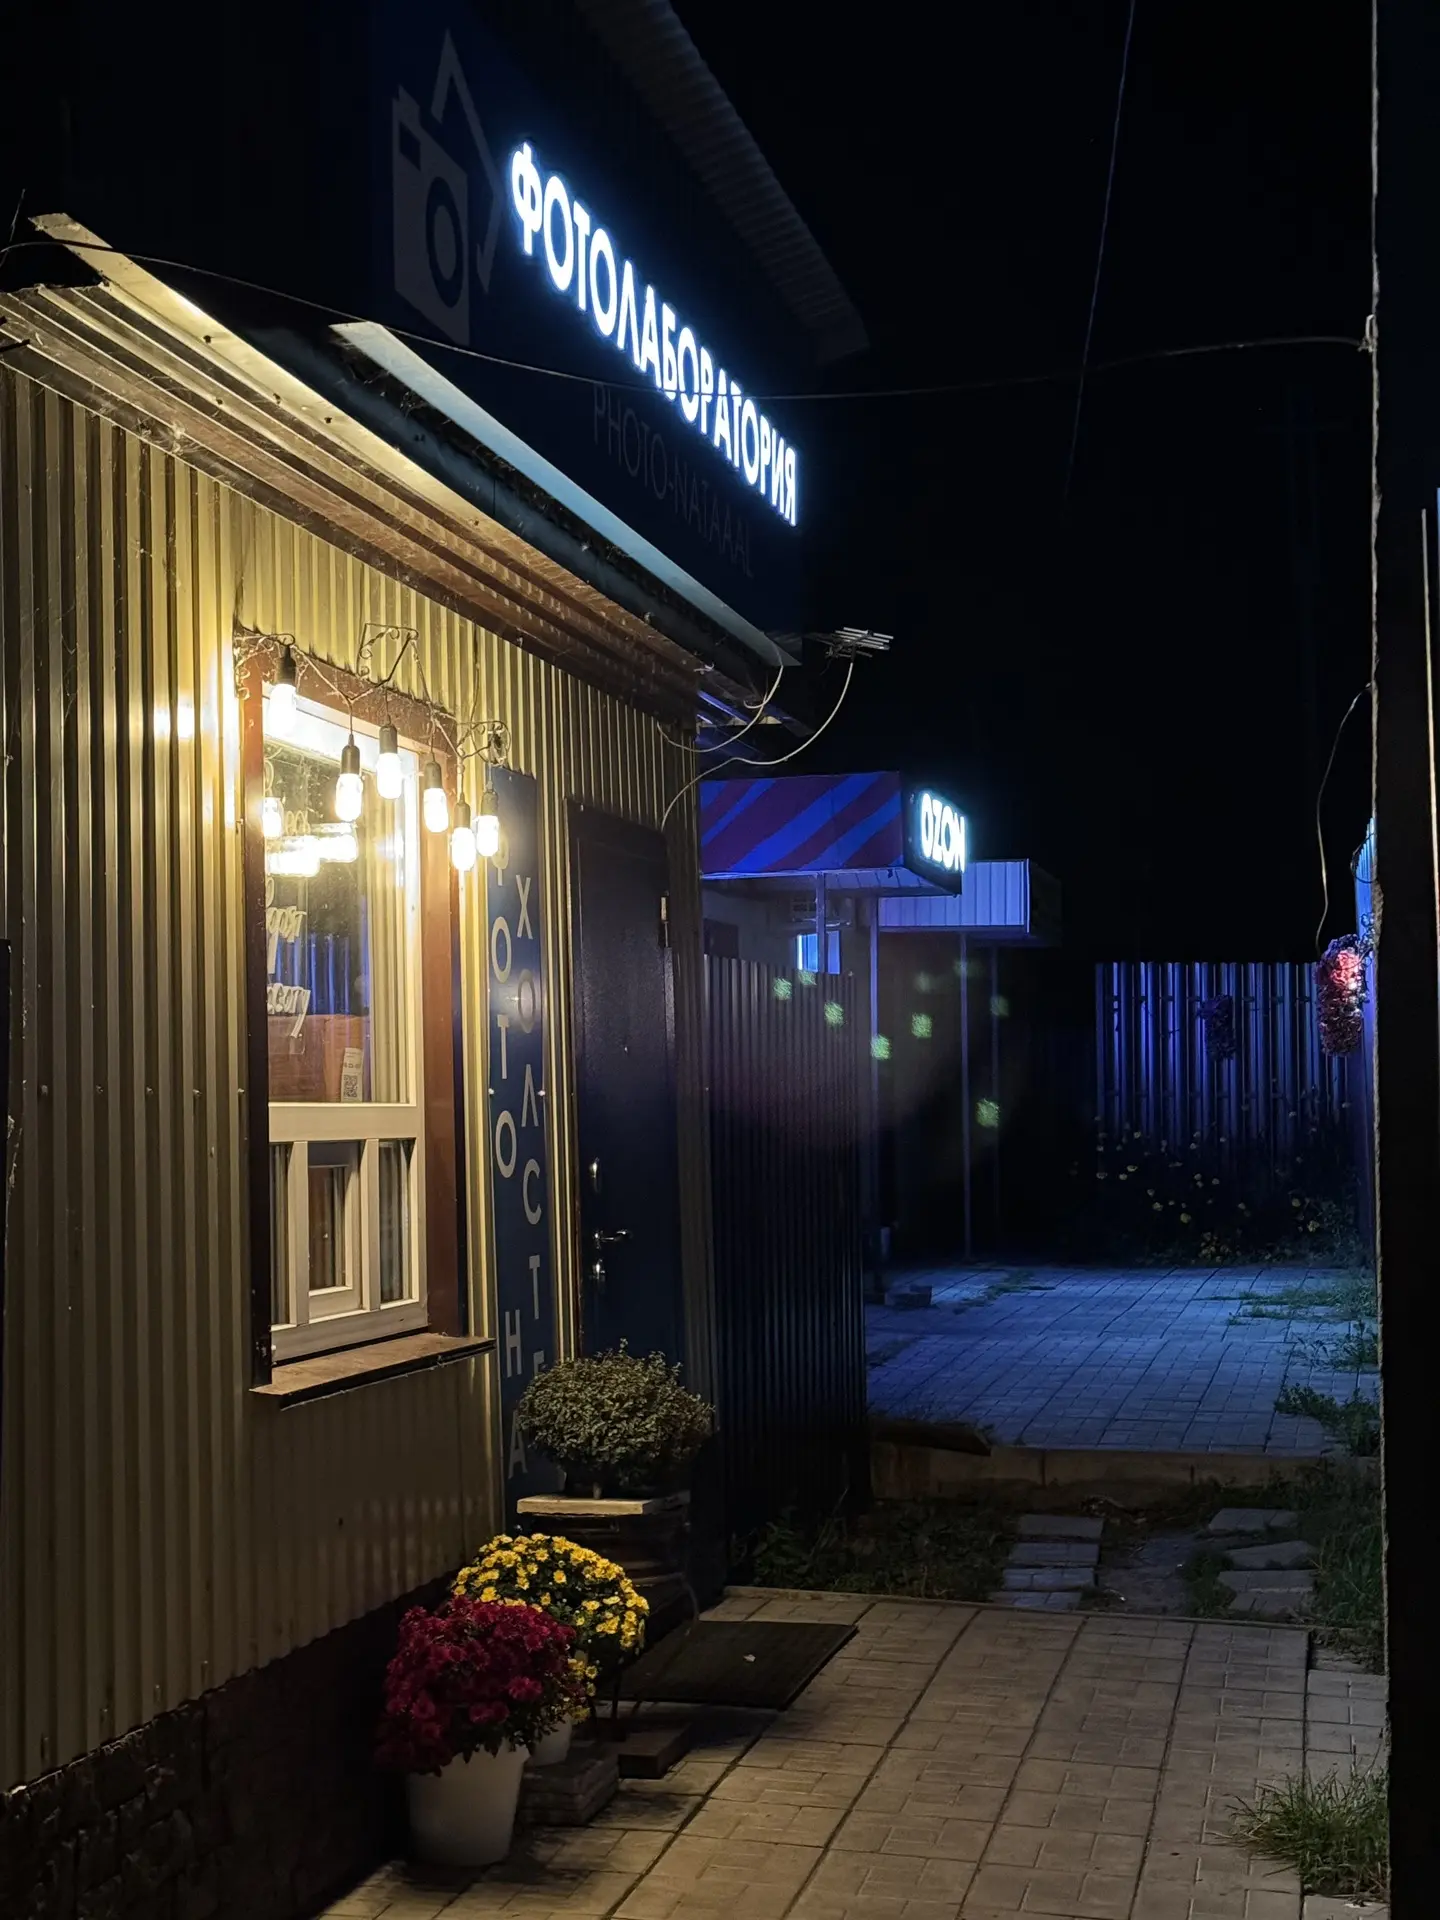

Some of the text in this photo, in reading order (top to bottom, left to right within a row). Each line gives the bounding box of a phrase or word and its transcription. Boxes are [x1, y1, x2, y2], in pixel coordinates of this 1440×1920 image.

[510, 140, 799, 527] ФОТОЛАБОРАТОРИЯ
[592, 383, 754, 580] PHOTO-NATAAAL
[921, 792, 967, 874] OZON
[504, 1308, 529, 1480] НА
